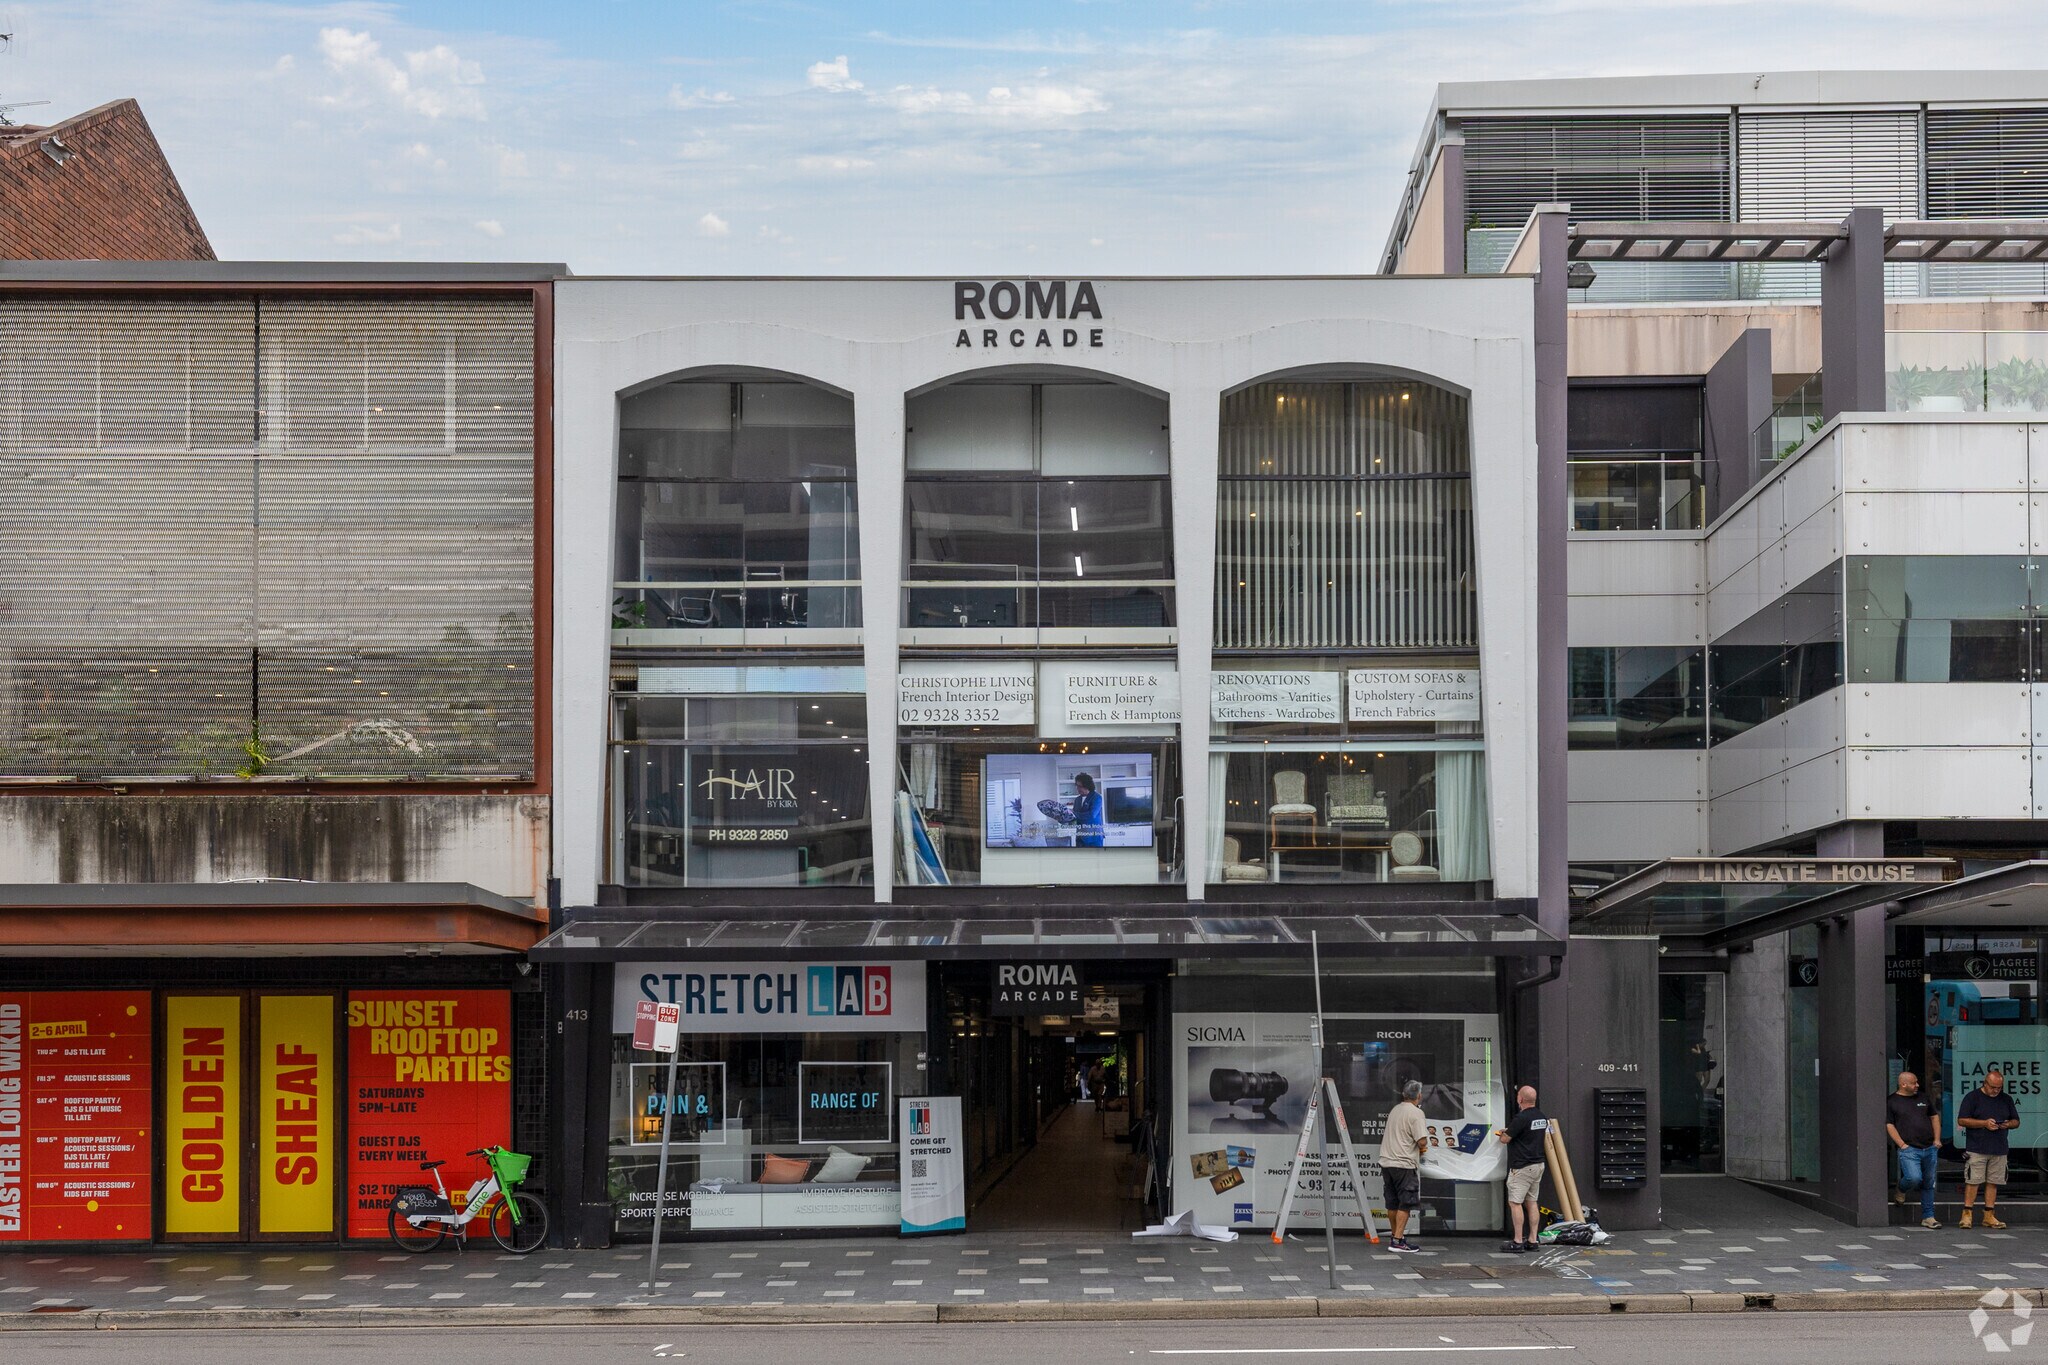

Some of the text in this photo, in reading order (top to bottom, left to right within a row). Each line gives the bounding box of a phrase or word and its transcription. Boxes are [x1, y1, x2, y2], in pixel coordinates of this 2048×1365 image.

[954, 281, 1102, 320] ROMA
[956, 329, 1103, 347] ARCADE
[901, 676, 1036, 688] CHRISTOPHE LIVING
[1068, 675, 1158, 687] FURNITURE &
[1218, 674, 1311, 685] RENOVATIONS
[1354, 673, 1466, 684] CUSTOM SOFAS &
[902, 690, 1034, 704] French Interior Design
[1068, 693, 1155, 706] Custom Joinery
[1218, 691, 1278, 702] Bathrooms
[1288, 691, 1332, 702] Vanities
[1355, 690, 1415, 703] Upholstery
[1425, 690, 1474, 700] Curtains
[901, 708, 1000, 722] 02 9328 3352
[1069, 710, 1181, 722] French & Hamptons
[1218, 707, 1265, 718] Kitchens
[1276, 708, 1336, 719] Wardrobes
[1355, 707, 1436, 717] French Fabrics
[698, 768, 797, 800] HAIR
[767, 800, 798, 808] BY KIRA
[709, 829, 789, 841] PH 9328 2850
[1698, 863, 1915, 882] LINGATE HOUSE
[1887, 959, 1922, 969] LAGREE
[1993, 958, 2036, 967] LAGREE
[1000, 964, 1078, 986] ROMA
[1887, 969, 1922, 979] FITNESS
[1993, 968, 2036, 977] FITNESS
[1000, 990, 1078, 1002] ARCADE
[348, 1000, 458, 1027] SUNSET
[643, 1004, 652, 1012] NO
[660, 1008, 677, 1016] BUS
[566, 1009, 588, 1020] 413
[637, 1012, 657, 1021] STOPPING
[660, 1015, 676, 1023] ZONE
[55, 1024, 85, 1035] APRIL
[1187, 1026, 1246, 1042] SIGMA
[1376, 1031, 1412, 1039] RICOH
[370, 1027, 498, 1055] ROOFTOP
[395, 1055, 511, 1083] PARTIES
[1598, 1064, 1615, 1072] 409
[1622, 1064, 1638, 1072] 411
[1961, 1061, 2041, 1076] LAGREE
[358, 1087, 425, 1099] SATURDAYS
[1961, 1080, 2041, 1095] FIESS
[648, 1094, 709, 1115] PAIN &
[810, 1092, 880, 1109] RANGE OF
[909, 1101, 930, 1109] STRETCH
[358, 1102, 417, 1113] 5PM-LATE
[0, 1003, 21, 1232] EASTER LONG WKND
[181, 1027, 225, 1203] GOLDEN
[275, 1043, 318, 1186] SHEAF
[911, 1122, 930, 1134] LAB
[358, 1136, 421, 1147] GUEST DJS
[358, 1150, 428, 1161] EVERY WEEK
[910, 1147, 952, 1155] STRETCHED
[358, 1183, 379, 1195] $12
[1308, 1179, 1336, 1192] 937
[680, 1190, 726, 1201] MOBILITY
[802, 1187, 892, 1198] IMPROVE POSTURE
[468, 1191, 490, 1213] Lime
